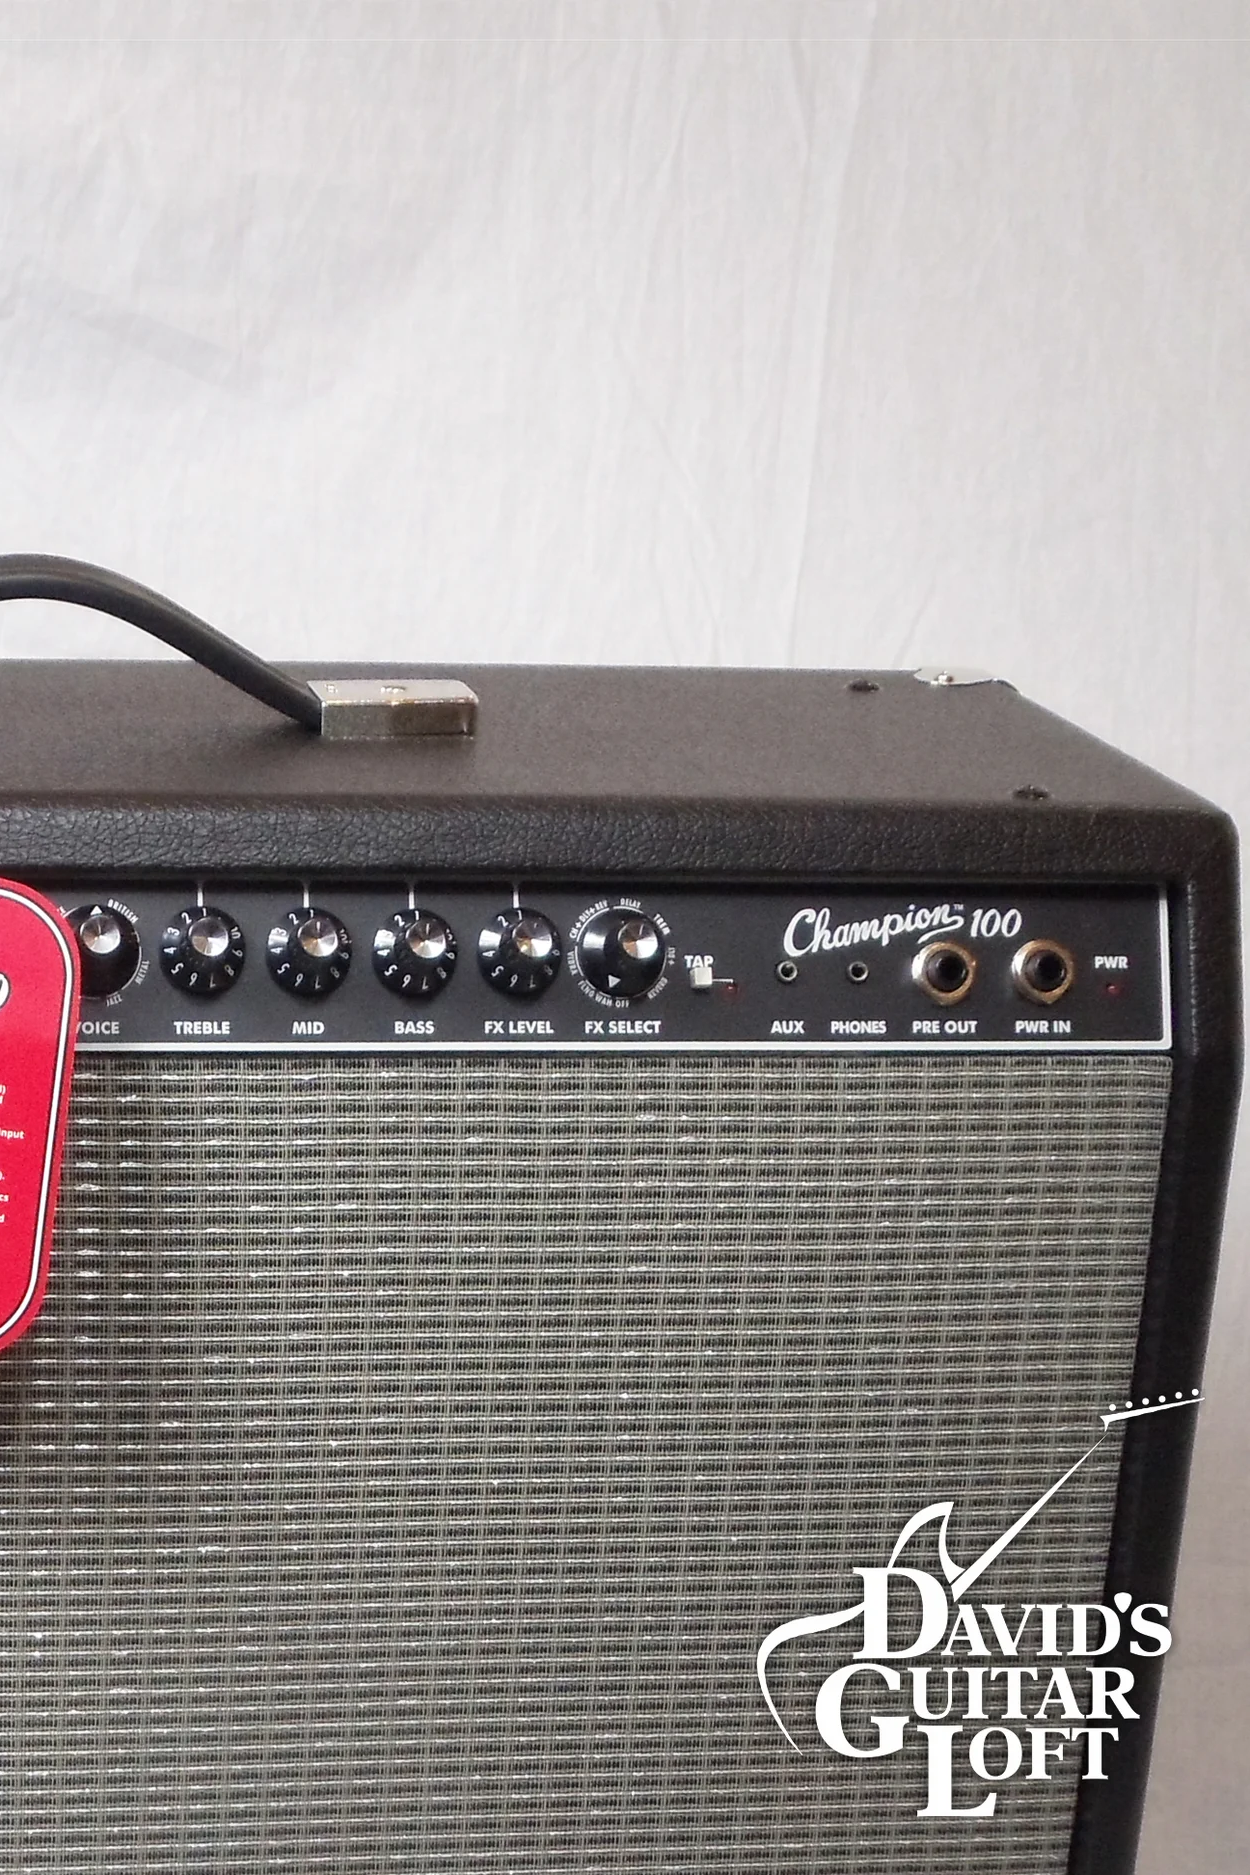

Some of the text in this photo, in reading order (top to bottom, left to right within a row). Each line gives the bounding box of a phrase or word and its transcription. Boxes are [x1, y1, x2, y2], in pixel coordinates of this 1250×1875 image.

[970, 908, 1023, 938] 100
[684, 955, 714, 968] TAP
[1094, 956, 1129, 969] PWR
[173, 1021, 230, 1035] TREBLE
[292, 1021, 325, 1035] MID
[394, 1021, 435, 1034] BASS
[484, 1021, 554, 1034] FX LEVEL
[585, 1021, 661, 1034] FX SELECT
[771, 1021, 805, 1034] AUX
[830, 1020, 887, 1034] PHONES
[912, 1020, 978, 1034] PRE OUT
[1015, 1020, 1071, 1034] PWR IN
